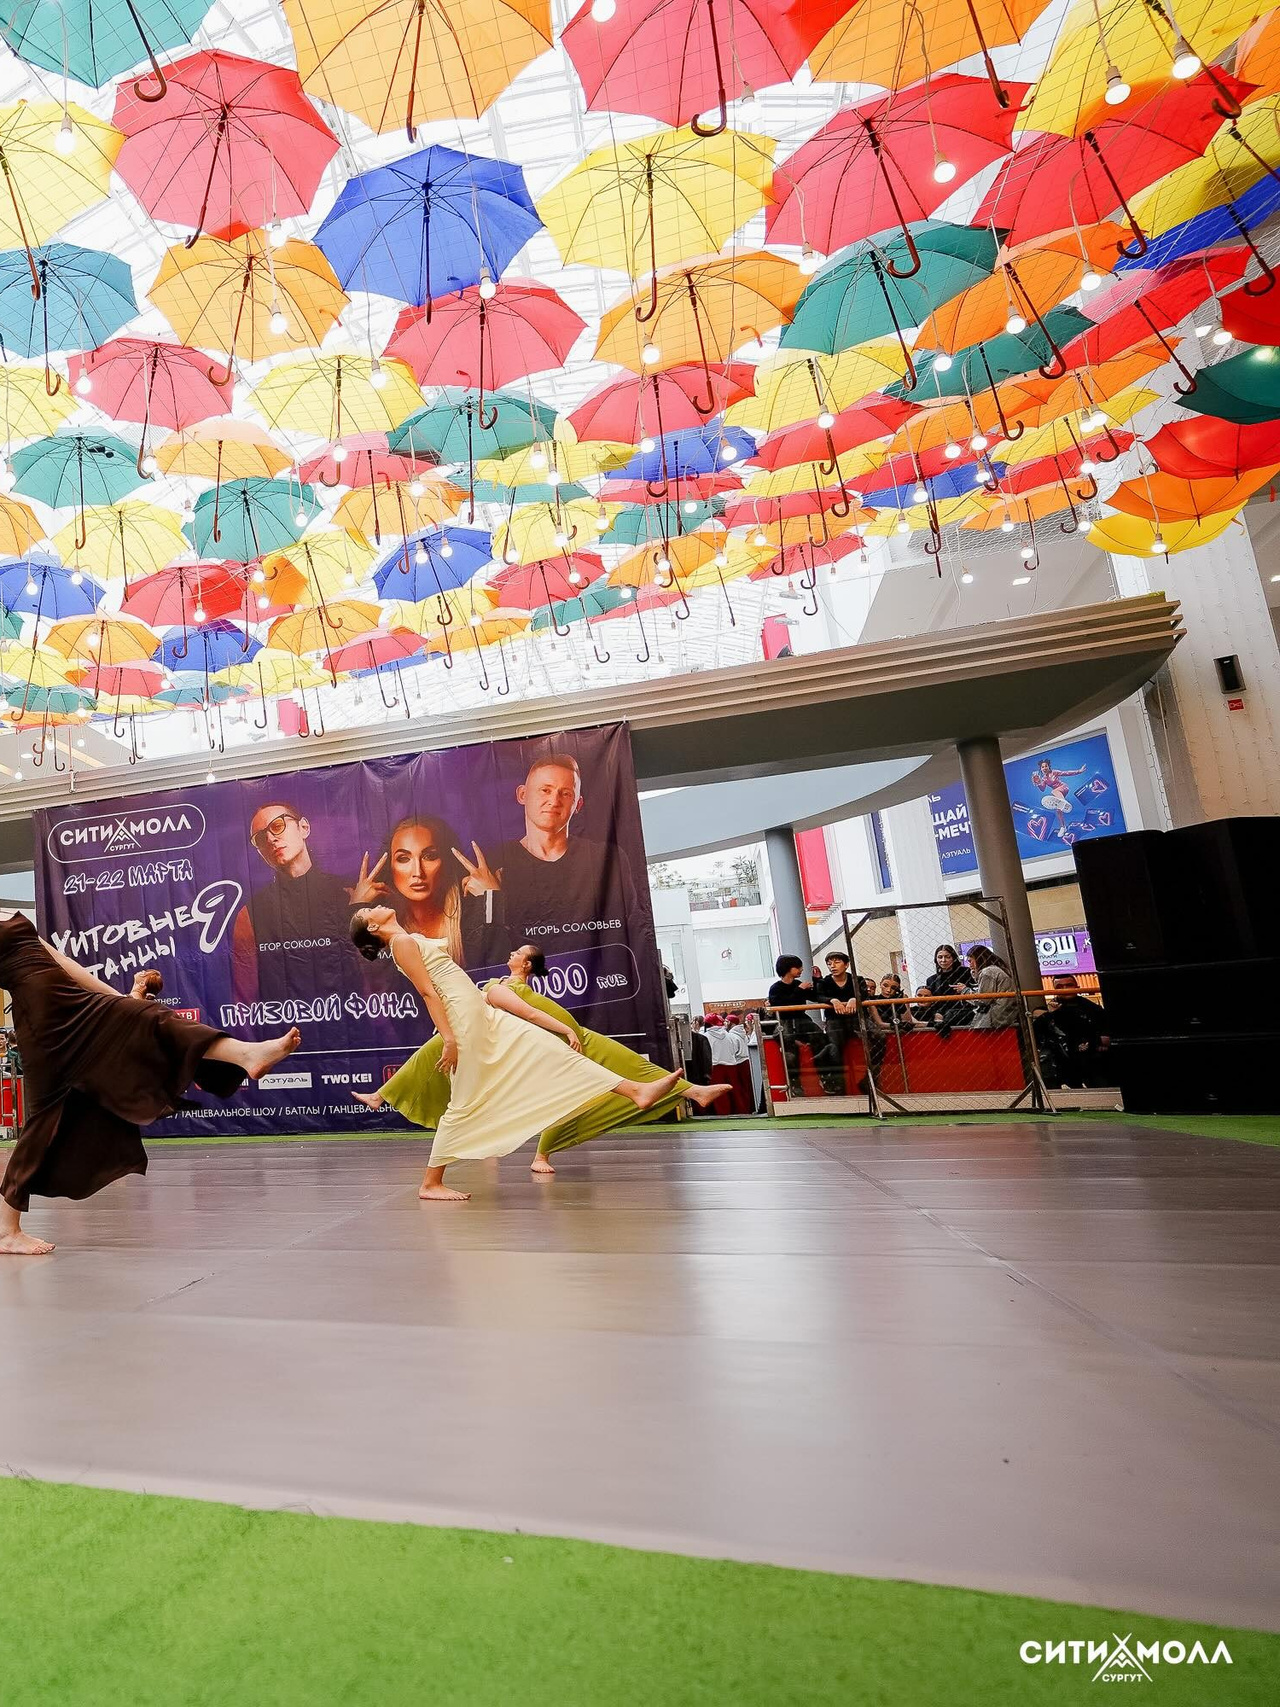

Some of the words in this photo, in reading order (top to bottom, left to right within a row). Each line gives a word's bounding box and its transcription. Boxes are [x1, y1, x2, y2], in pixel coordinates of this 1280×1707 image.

[109, 842, 135, 852] СУРГУТ
[63, 870, 125, 895] 21-22
[128, 859, 193, 887] МАРТА
[525, 925, 560, 936] ИГОРЬ
[562, 919, 622, 934] СОЛОВЬЕВ
[259, 942, 282, 952] ЕГОР
[283, 938, 332, 950] СОКОЛОВ
[221, 994, 341, 1027] ПРИЗОВОЙ
[344, 992, 418, 1019] ФОНД
[321, 1074, 350, 1084] TWO
[352, 1073, 373, 1083] KEI
[252, 1107, 277, 1117] ШОУ
[285, 1105, 320, 1116] БАТТЛЫ
